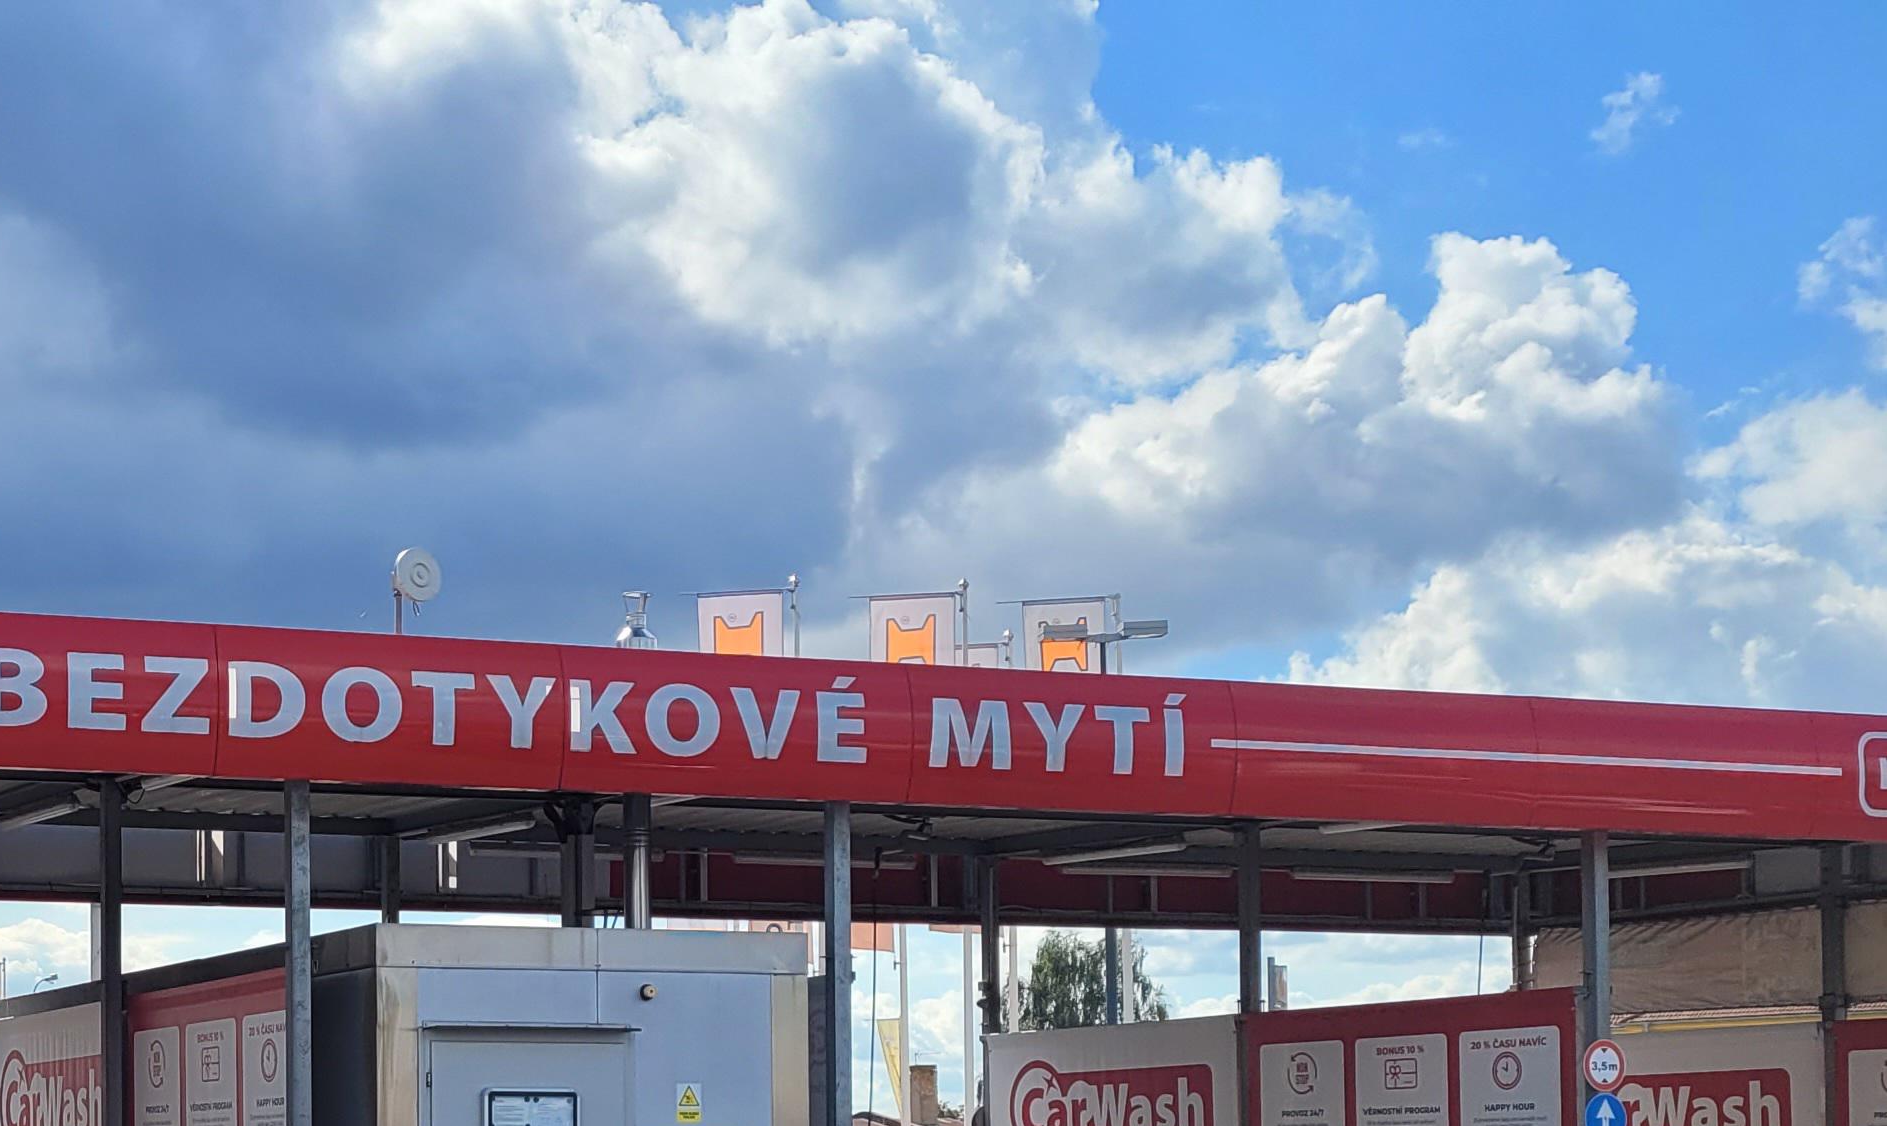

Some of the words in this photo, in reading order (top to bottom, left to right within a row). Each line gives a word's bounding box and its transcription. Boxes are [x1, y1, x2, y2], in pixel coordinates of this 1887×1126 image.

[929, 693, 1187, 777] MYTÍ
[1470, 1041, 1482, 1050] 20
[1483, 1040, 1491, 1049] %
[1493, 1037, 1516, 1048] ČASU
[1519, 1035, 1547, 1047] NAVÍC
[1376, 1046, 1405, 1055] BONUS
[1407, 1045, 1415, 1054] 10
[1417, 1045, 1424, 1053] %
[1362, 1106, 1402, 1115] VĚRNOSTNÍ
[1404, 1106, 1440, 1114] PROGRAM
[1484, 1103, 1510, 1112] HAPPY
[1513, 1102, 1535, 1111] HOUR
[1874, 1111, 1887, 1119] PRO
